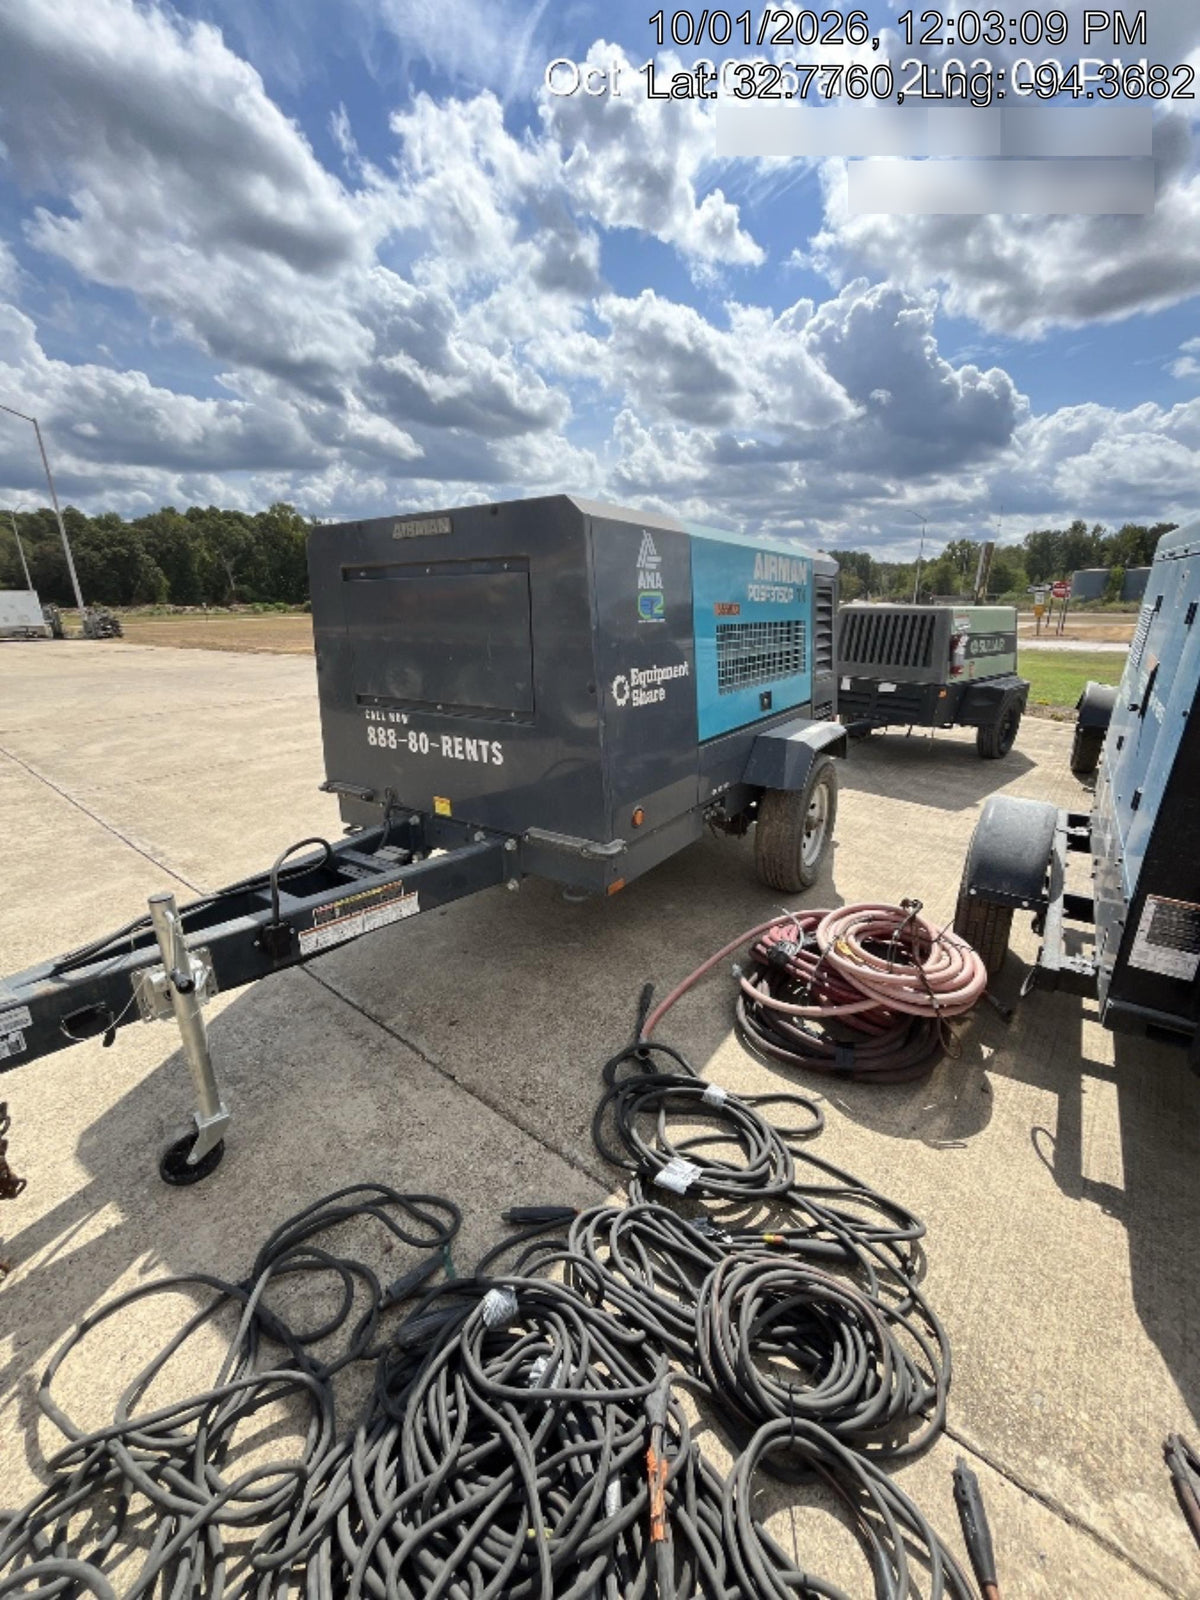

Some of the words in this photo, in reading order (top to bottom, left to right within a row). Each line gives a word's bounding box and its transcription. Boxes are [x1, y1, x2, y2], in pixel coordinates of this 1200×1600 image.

[637, 570, 664, 589] ANA
[753, 552, 807, 585] AIRMAN
[630, 661, 689, 688] Equipment
[632, 688, 666, 707] Share
[365, 708, 387, 721] CALL
[367, 725, 504, 765] 888-80-RENTS
